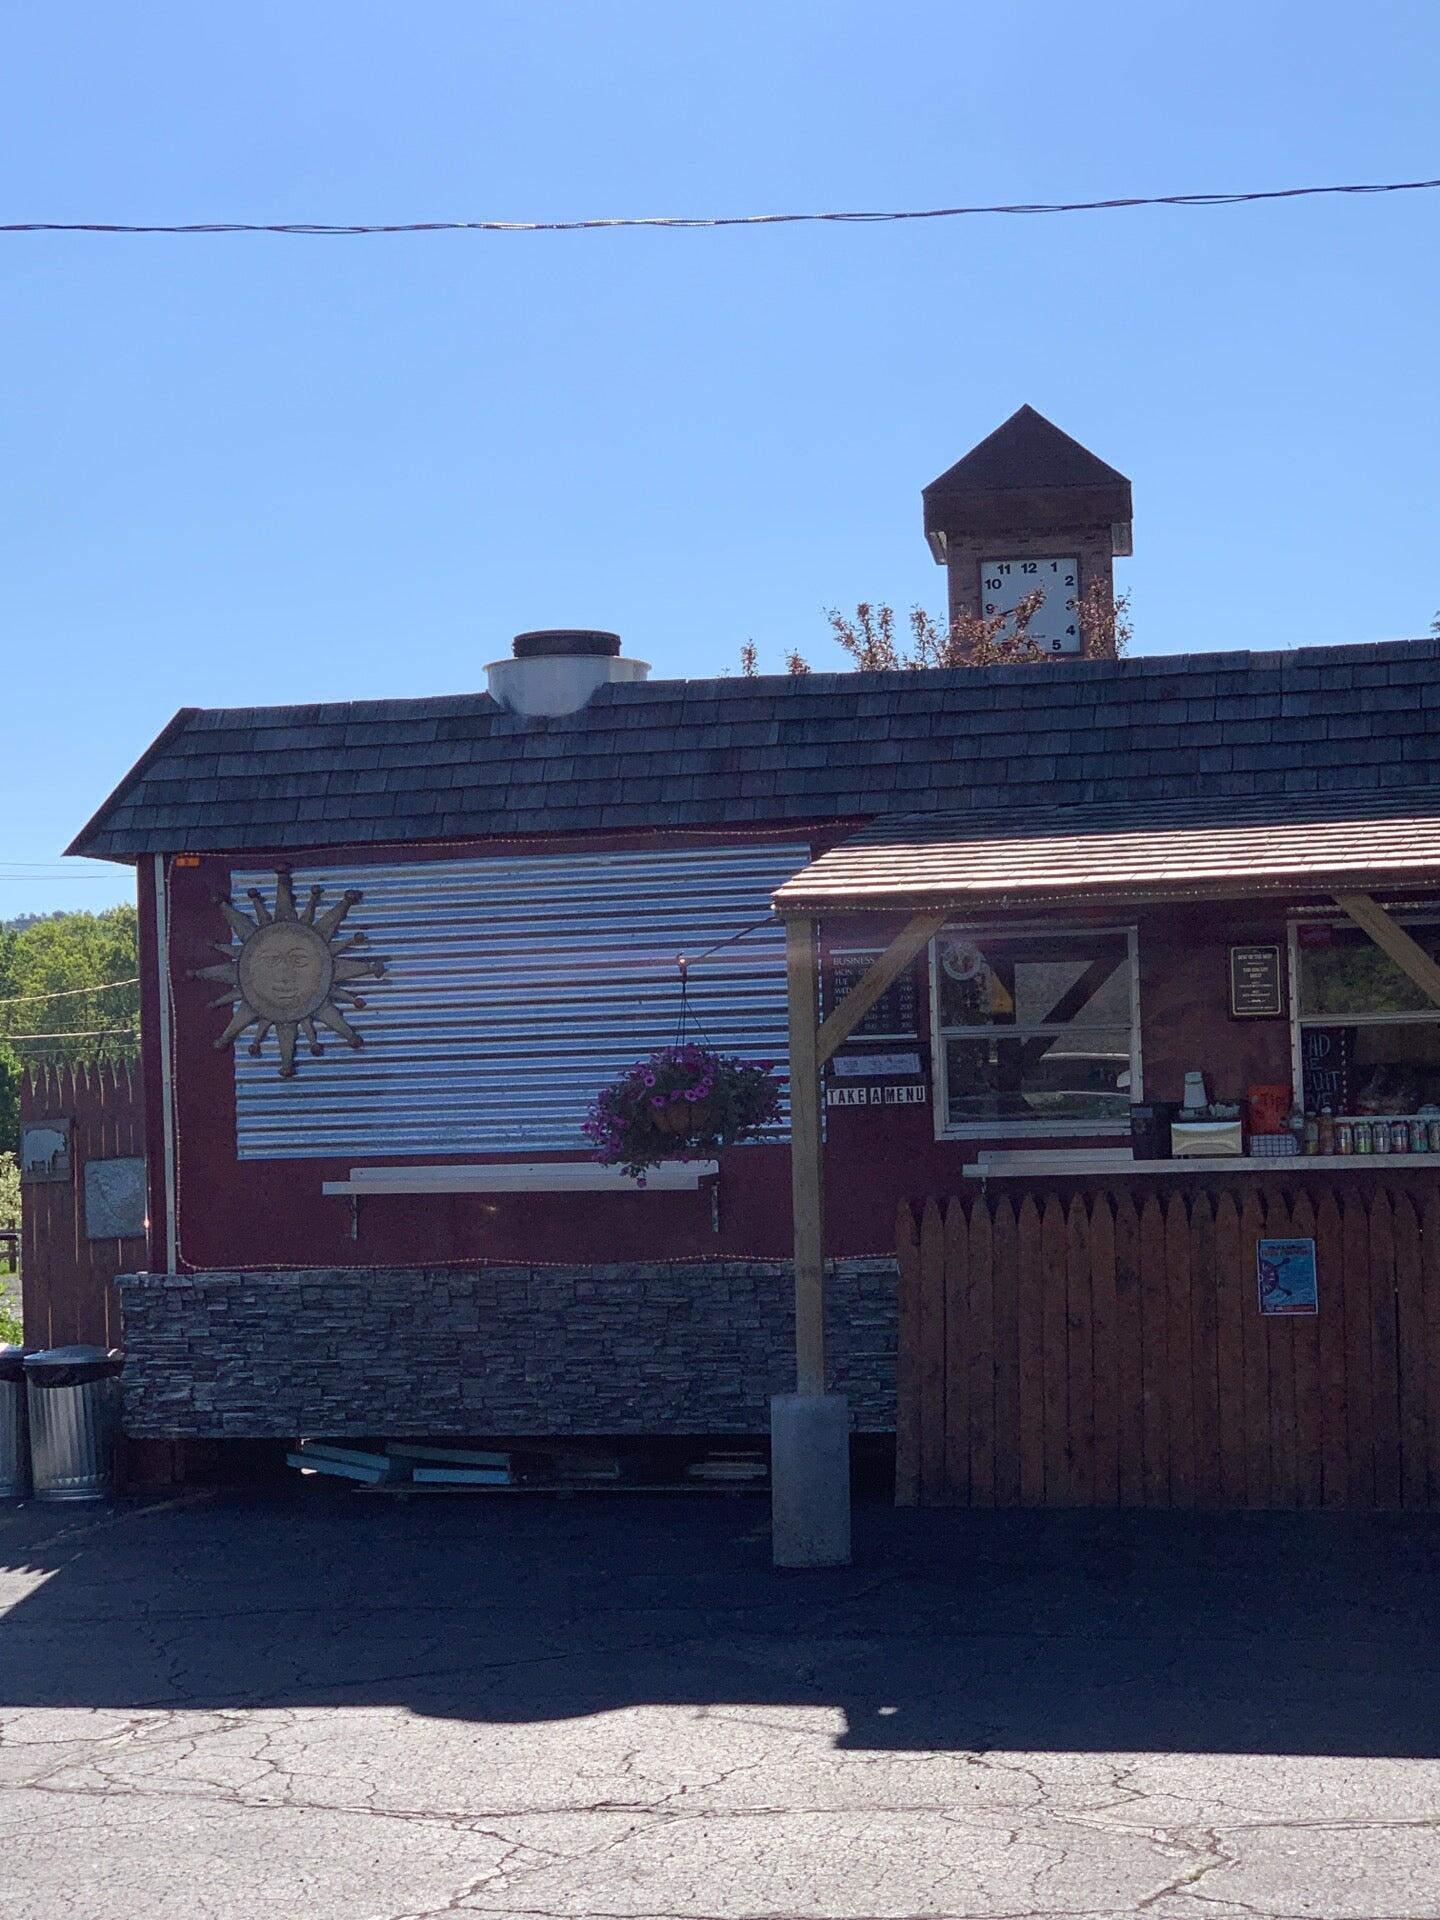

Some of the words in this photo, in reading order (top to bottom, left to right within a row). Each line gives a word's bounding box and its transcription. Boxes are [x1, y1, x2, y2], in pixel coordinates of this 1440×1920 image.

[997, 564, 1011, 575] 11
[1021, 562, 1037, 573] 12
[1050, 562, 1057, 572] 1
[985, 579, 1002, 589] 10
[1065, 575, 1074, 586] 2
[985, 603, 995, 614] 9
[1066, 625, 1075, 635] 4
[1052, 639, 1061, 650] 5
[833, 956, 875, 966] BUSINESS
[829, 1089, 865, 1104] TAKE
[871, 1088, 880, 1103] A
[885, 1087, 924, 1103] MENU
